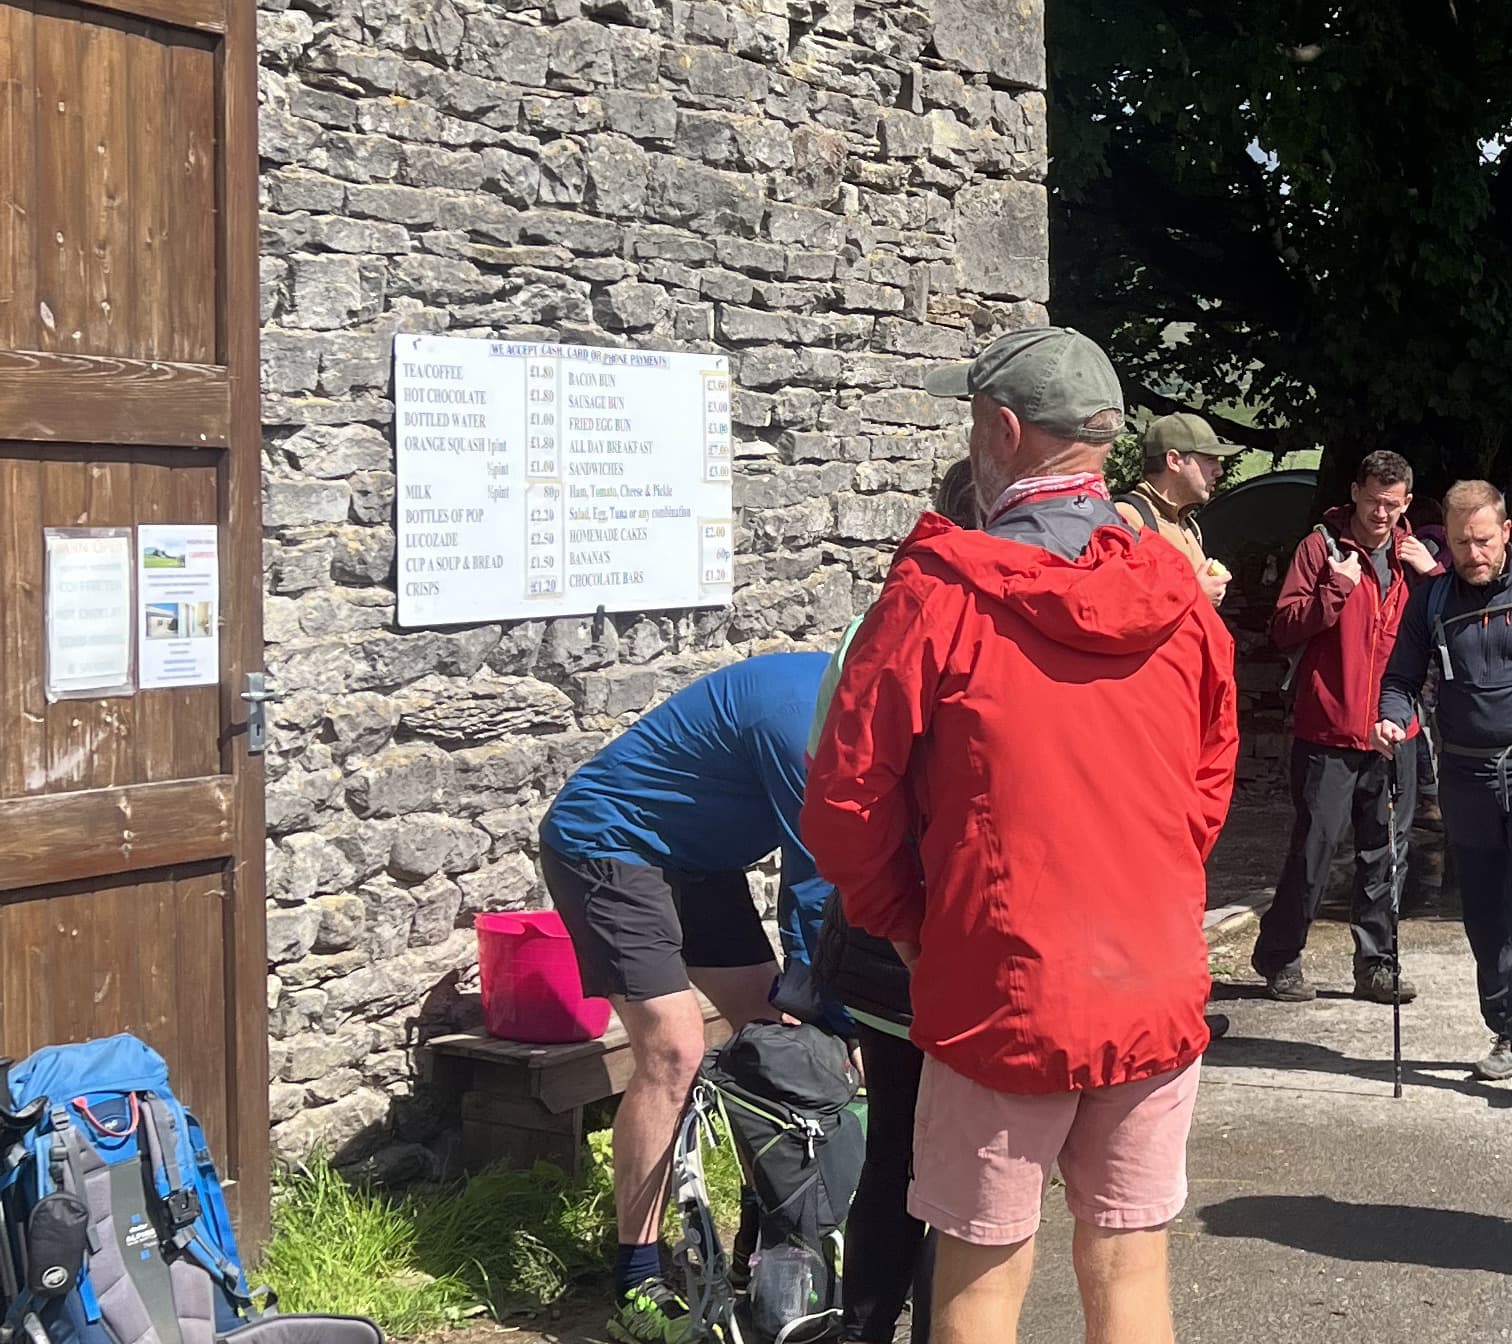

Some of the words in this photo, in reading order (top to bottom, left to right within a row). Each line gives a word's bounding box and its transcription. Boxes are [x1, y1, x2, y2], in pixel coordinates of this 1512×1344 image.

[507, 344, 537, 355] ACCEPT
[403, 362, 463, 379] TEA/COFFEE
[568, 371, 597, 387] BACON
[599, 373, 616, 388] BUN
[403, 387, 425, 403] HOT
[427, 388, 487, 405] CHOCOLATE
[568, 394, 606, 409] SAUSAGE
[608, 396, 624, 410] BUN
[404, 412, 450, 427] BOTTLED
[452, 413, 486, 428] WATER
[569, 416, 594, 431] FRIED
[595, 417, 613, 431] EGG
[615, 418, 632, 432] BUN
[404, 436, 446, 451] ORANGE
[447, 437, 485, 455] SQUASH
[569, 440, 586, 454] ALL
[587, 440, 604, 454] DAY
[606, 440, 653, 455] BREAKFAST
[568, 462, 624, 476] SANDWICHES
[405, 484, 432, 500] MILK
[620, 484, 643, 497] Cheese
[653, 483, 673, 497] Pickle
[405, 508, 449, 524] BOTTLES
[451, 508, 463, 523] OF
[465, 508, 484, 523] POP
[609, 506, 627, 519] Tuna
[629, 509, 637, 519] or
[651, 505, 691, 519] combination
[405, 532, 458, 548] LUCOZADE
[569, 528, 619, 543] HOMEMADE
[620, 527, 648, 541] CAKES
[405, 557, 425, 572] CUP
[427, 557, 436, 571] A
[436, 556, 461, 571] SOUP
[462, 556, 471, 570] &
[472, 555, 504, 570] BREAD
[569, 572, 621, 588] CHOCOLATE
[622, 571, 644, 585] BARS
[405, 581, 440, 596] CRISPS
